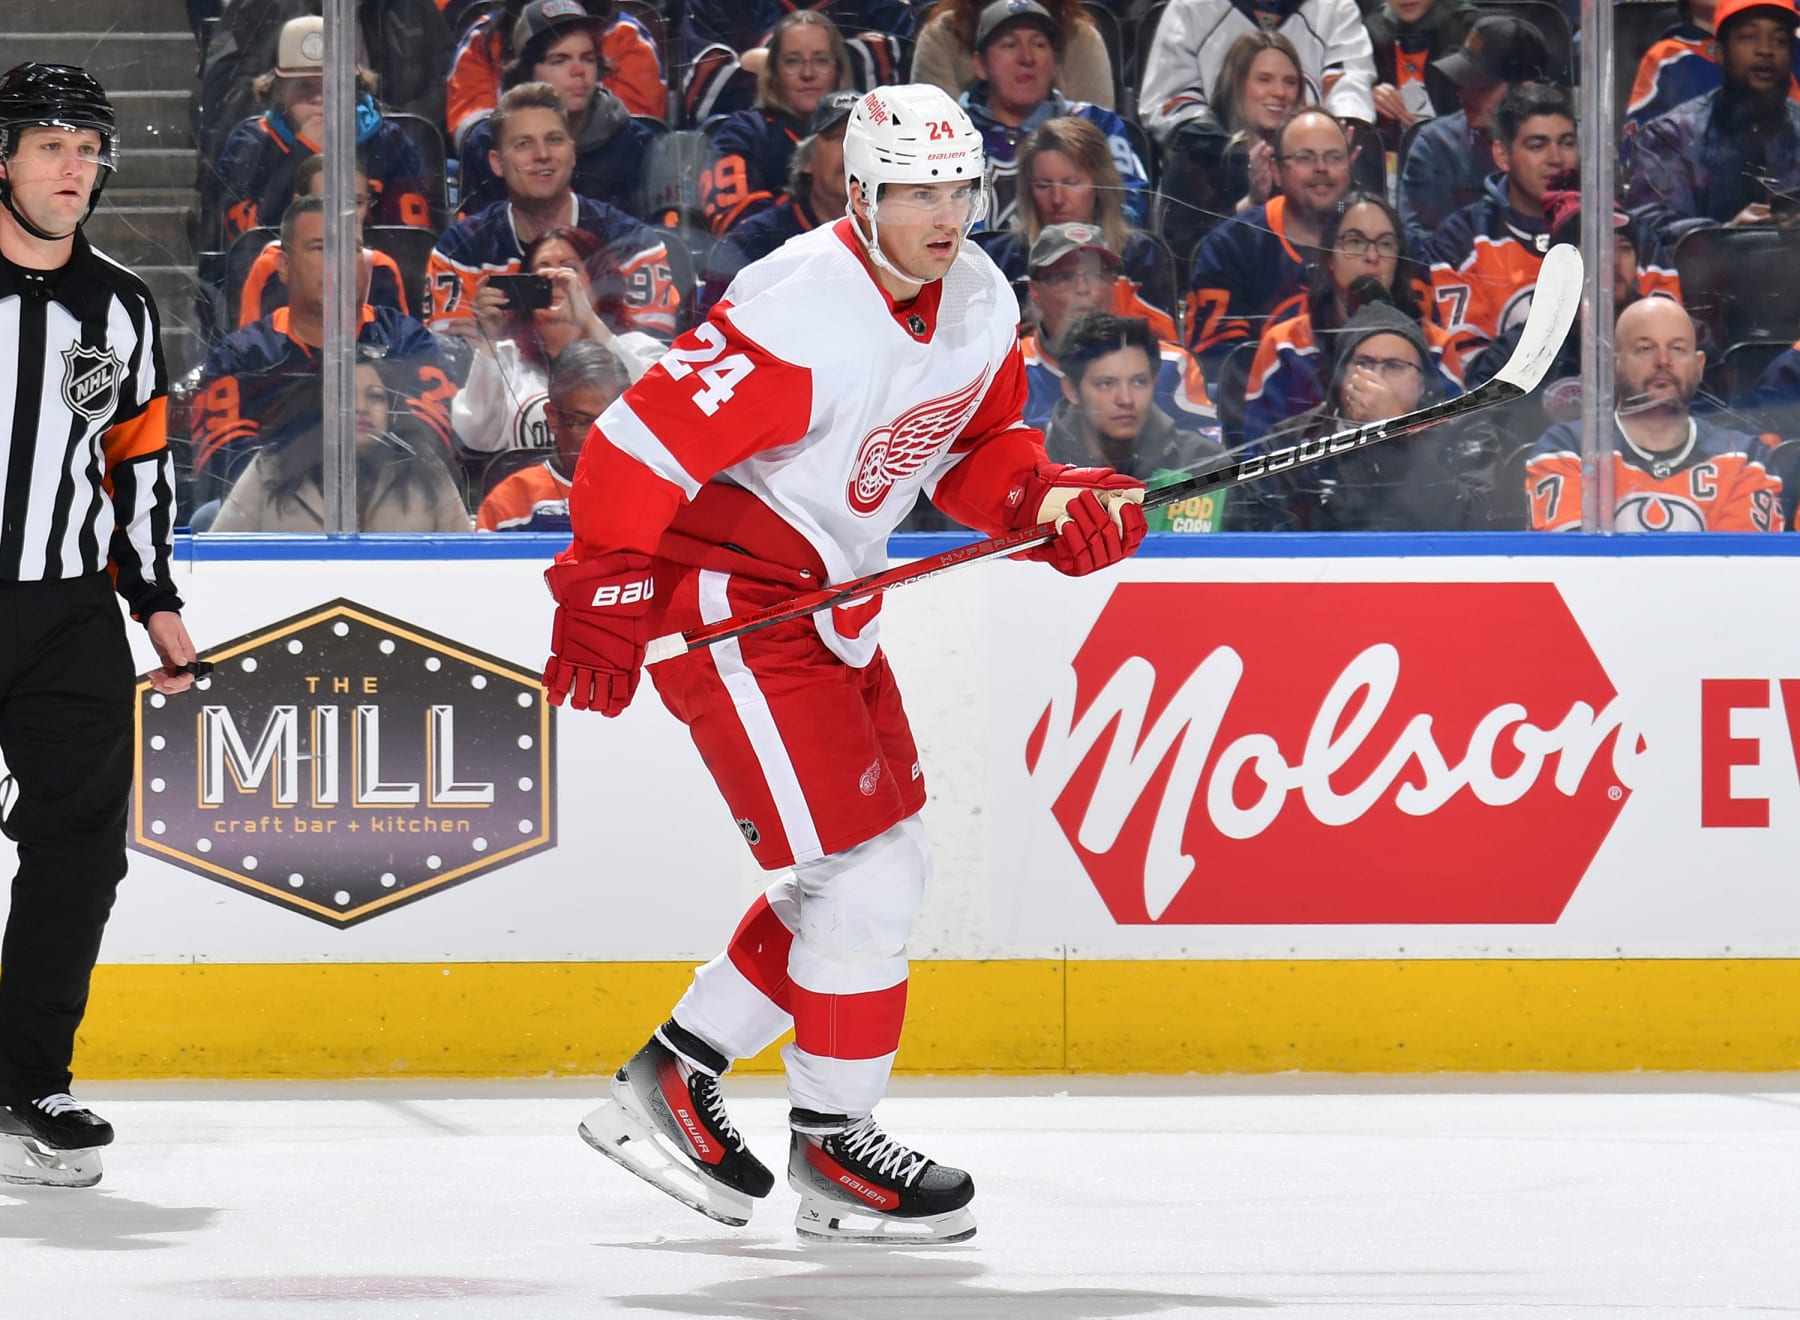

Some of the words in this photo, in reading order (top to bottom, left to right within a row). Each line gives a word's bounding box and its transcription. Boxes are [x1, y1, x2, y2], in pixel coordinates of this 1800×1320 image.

[864, 93, 889, 127] meijer
[925, 121, 954, 141] 24
[927, 151, 966, 161] BAUER
[76, 367, 111, 401] NHL
[659, 321, 756, 417] 24
[1237, 420, 1388, 481] BAUER
[1691, 463, 1728, 500] C
[939, 525, 1050, 564] HYPERLITE
[305, 676, 378, 694] THE
[198, 705, 494, 808] MILL
[1025, 642, 1648, 921] Molson
[214, 816, 283, 833] craft
[294, 816, 337, 833] bar
[371, 816, 470, 833] kitchen
[677, 1109, 710, 1153] BAUER
[839, 1175, 886, 1205] BAUER
